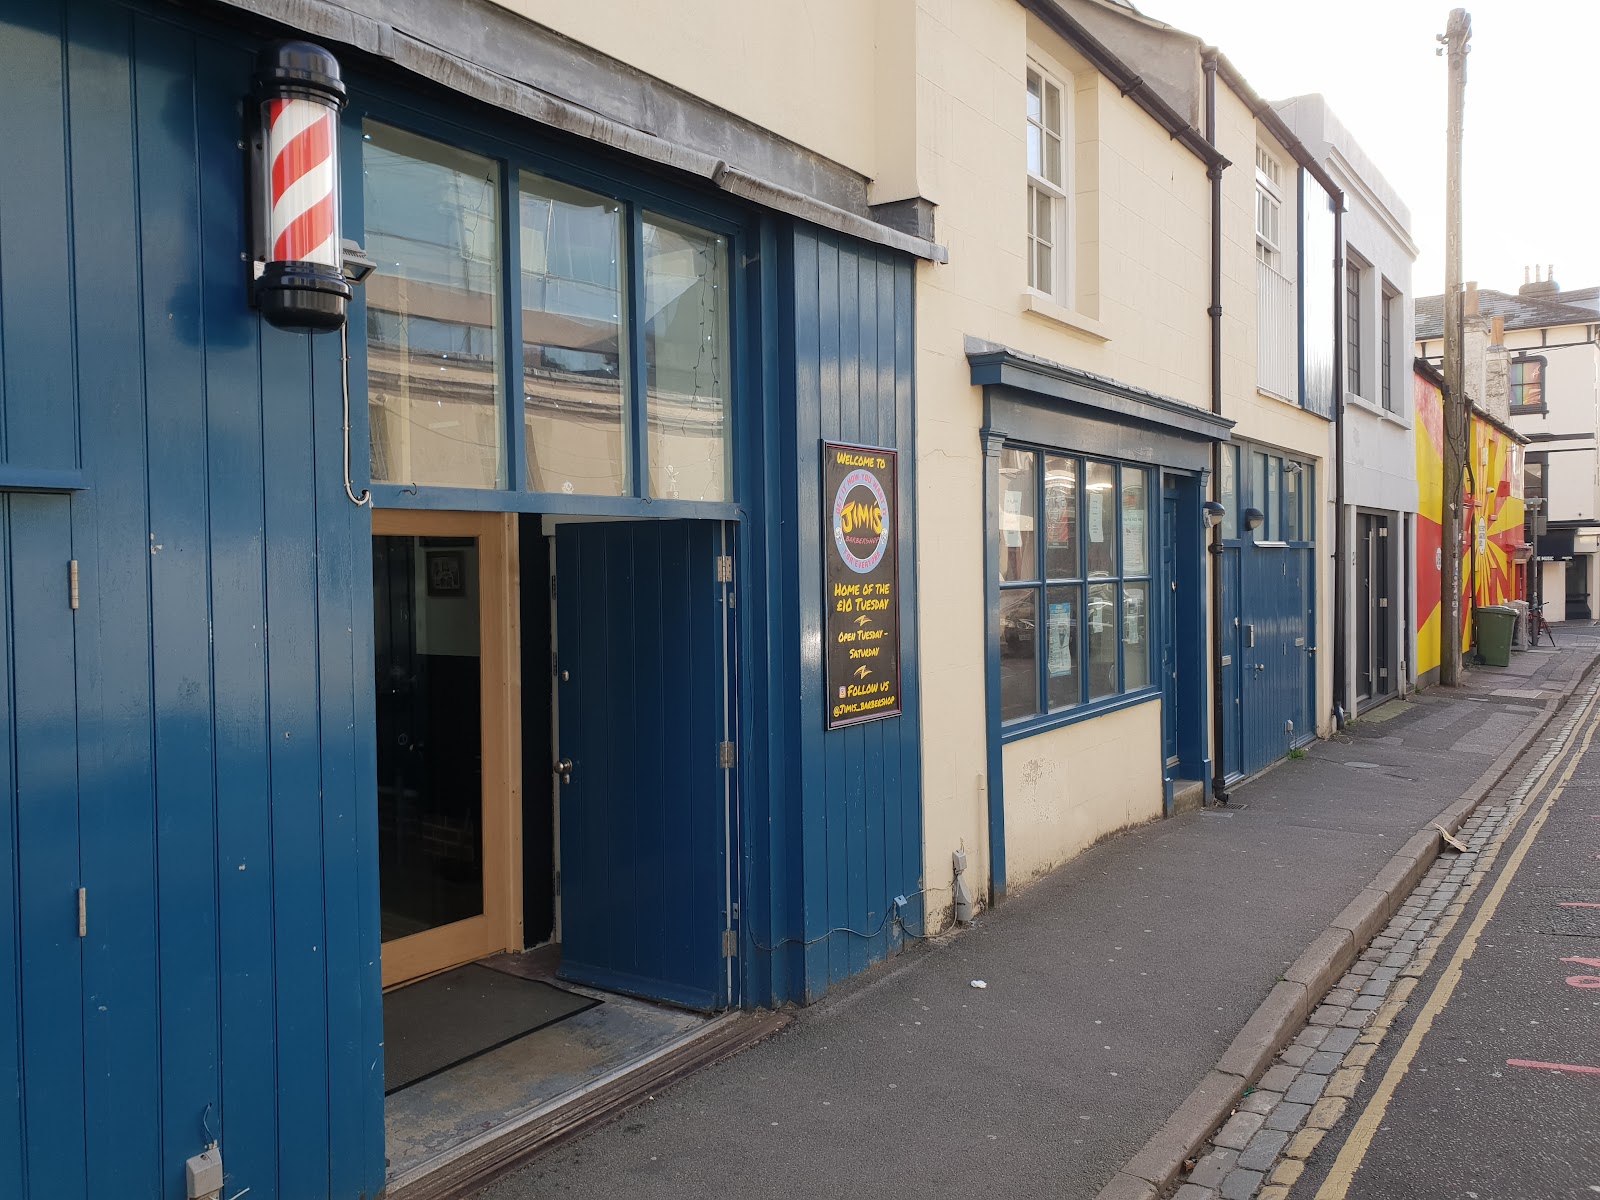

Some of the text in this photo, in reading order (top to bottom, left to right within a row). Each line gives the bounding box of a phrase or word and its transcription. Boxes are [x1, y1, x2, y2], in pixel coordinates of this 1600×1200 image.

[837, 452, 886, 469] WELCOME TO
[847, 473, 859, 486] HOW
[861, 473, 873, 484] YOU
[872, 480, 886, 504] WANT
[841, 500, 882, 534] JIMI'S
[845, 535, 880, 545] BARBERSHOP
[843, 549, 881, 569] FOR EVERYONE
[834, 583, 891, 596] HOME OF THE
[836, 597, 889, 612] £10 TUESDAY
[838, 631, 856, 643] OPEN
[857, 629, 884, 641] TUESDAY
[849, 647, 880, 660] SATURDAY
[847, 681, 890, 698] FOLLOW US
[833, 696, 895, 717] @JIMIS_BARBERSHOP
